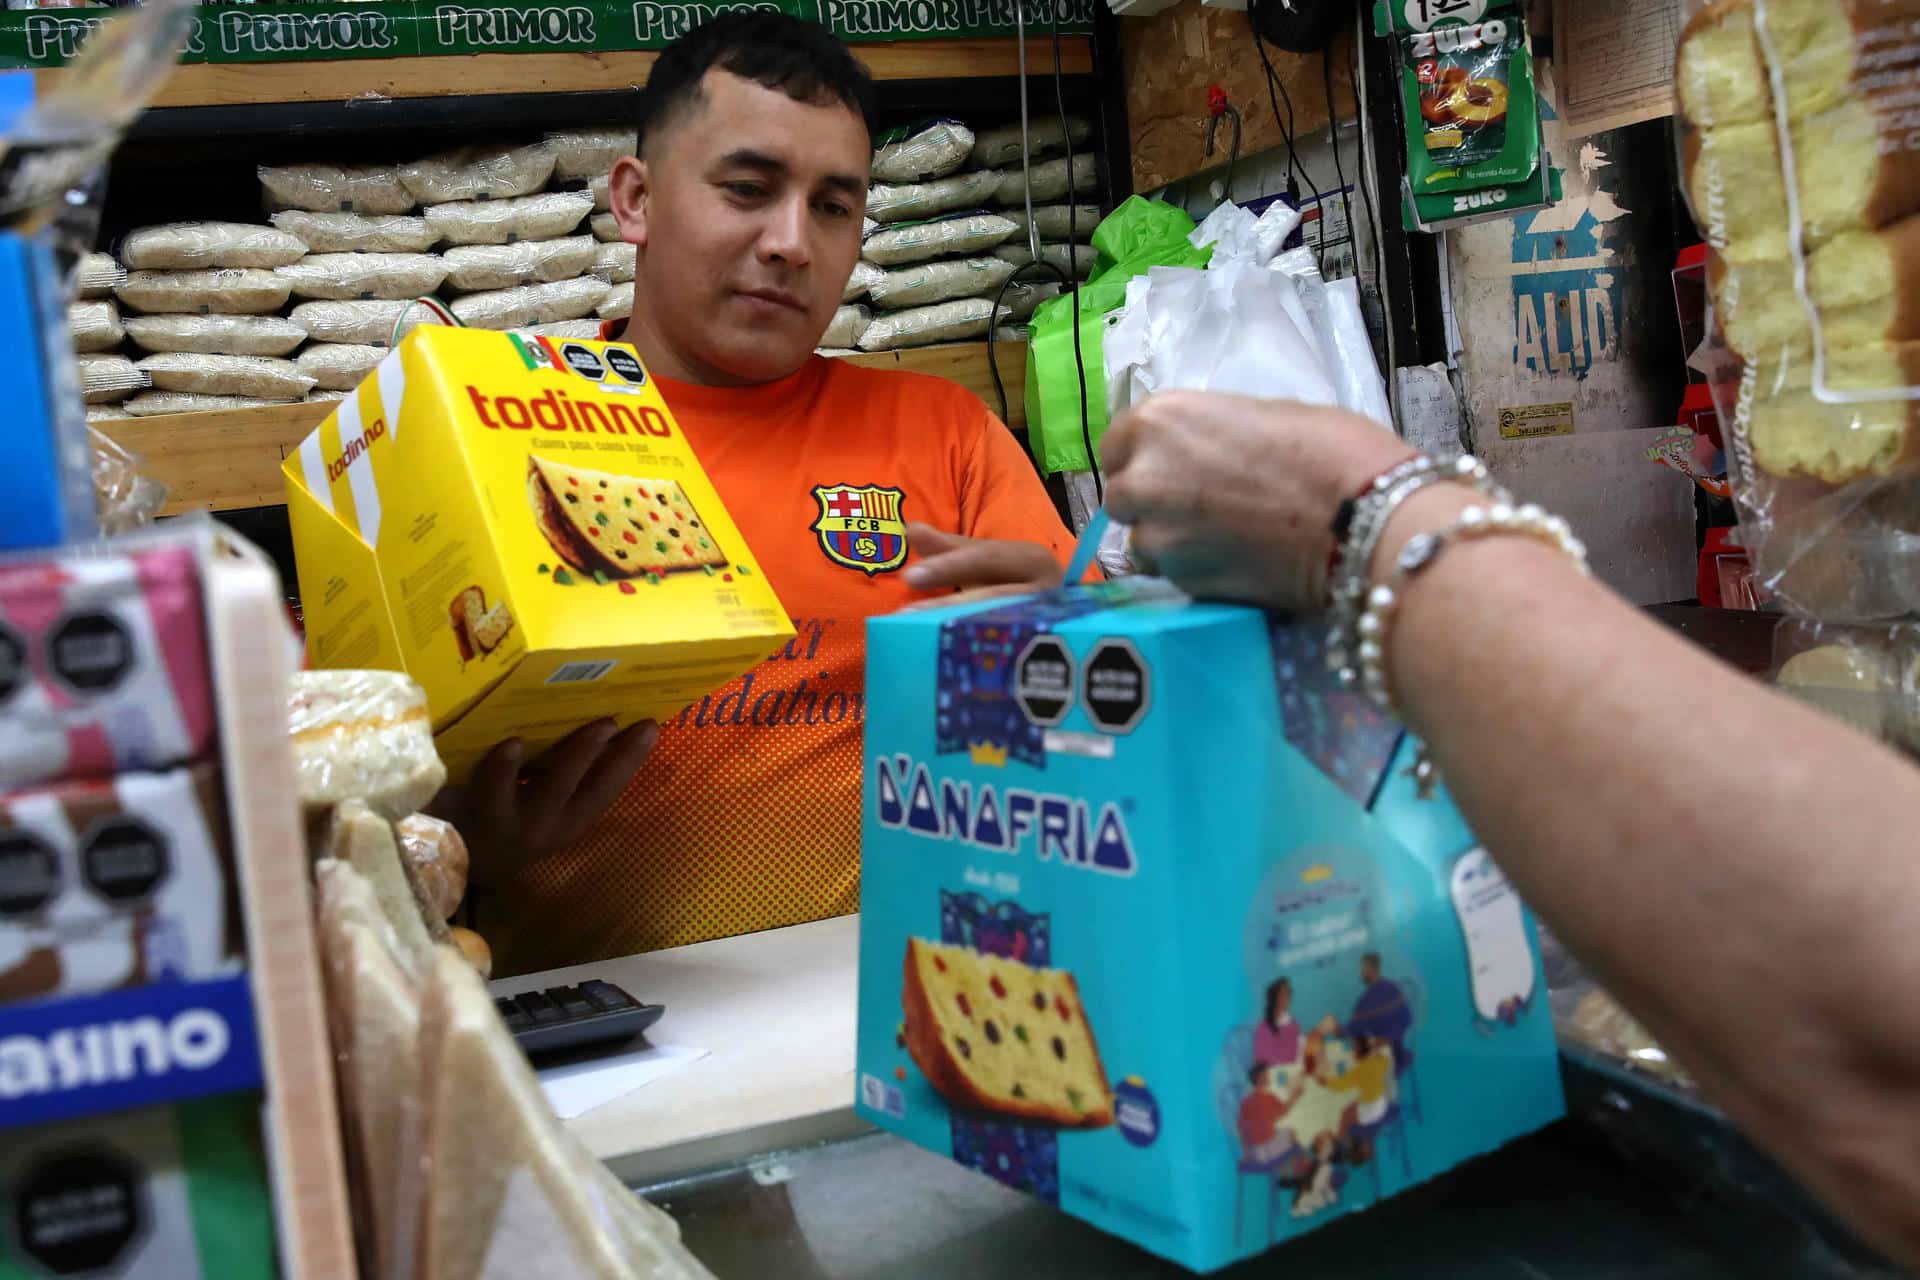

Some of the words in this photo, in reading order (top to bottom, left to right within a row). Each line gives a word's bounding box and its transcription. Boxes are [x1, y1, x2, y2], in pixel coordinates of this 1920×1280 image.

[219, 11, 393, 53] PRIMOR
[437, 4, 597, 45] PRIMOR
[1410, 20, 1508, 58] ZUKO
[1453, 189, 1507, 212] ZUKO
[465, 384, 672, 439] todinno
[327, 417, 386, 483] todinno
[844, 518, 880, 532] FCB
